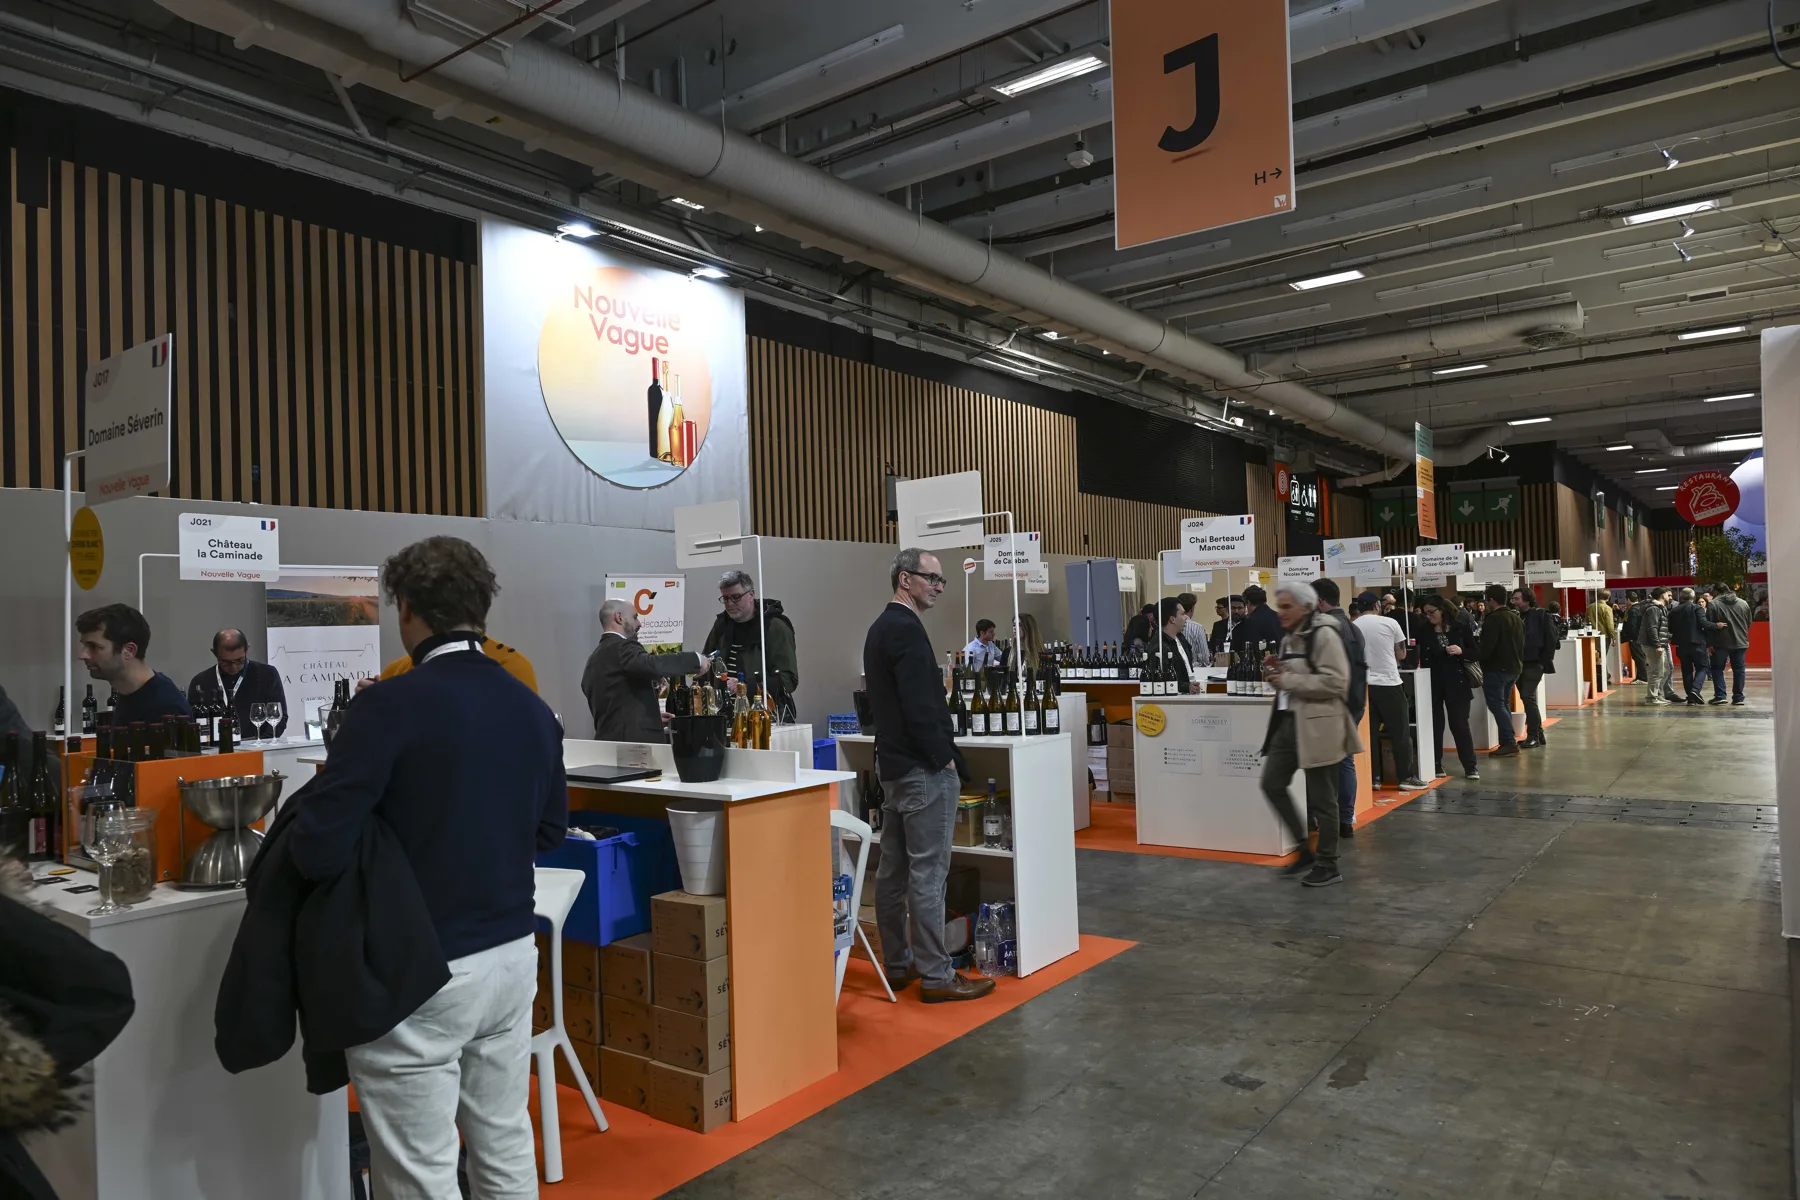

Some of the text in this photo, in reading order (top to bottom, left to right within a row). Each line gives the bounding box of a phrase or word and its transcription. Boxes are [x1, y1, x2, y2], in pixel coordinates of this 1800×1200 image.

[1157, 32, 1220, 152] J
[1254, 171, 1267, 186] H
[573, 283, 682, 332] Nouvelle
[588, 313, 669, 355] Vague
[88, 407, 164, 447] Domaine Séverin
[127, 474, 150, 491] Vague
[1680, 472, 1735, 491] RESTAURANT
[190, 518, 212, 526] J021
[208, 538, 253, 550] Château
[1189, 534, 1245, 544] Chai Berteaud
[1199, 544, 1236, 552] Manceau
[197, 549, 264, 561] la Caminade
[1002, 557, 1029, 565] Caaban
[200, 570, 261, 580] Nouvelle Vague
[302, 661, 349, 670] CHÂTEAU
